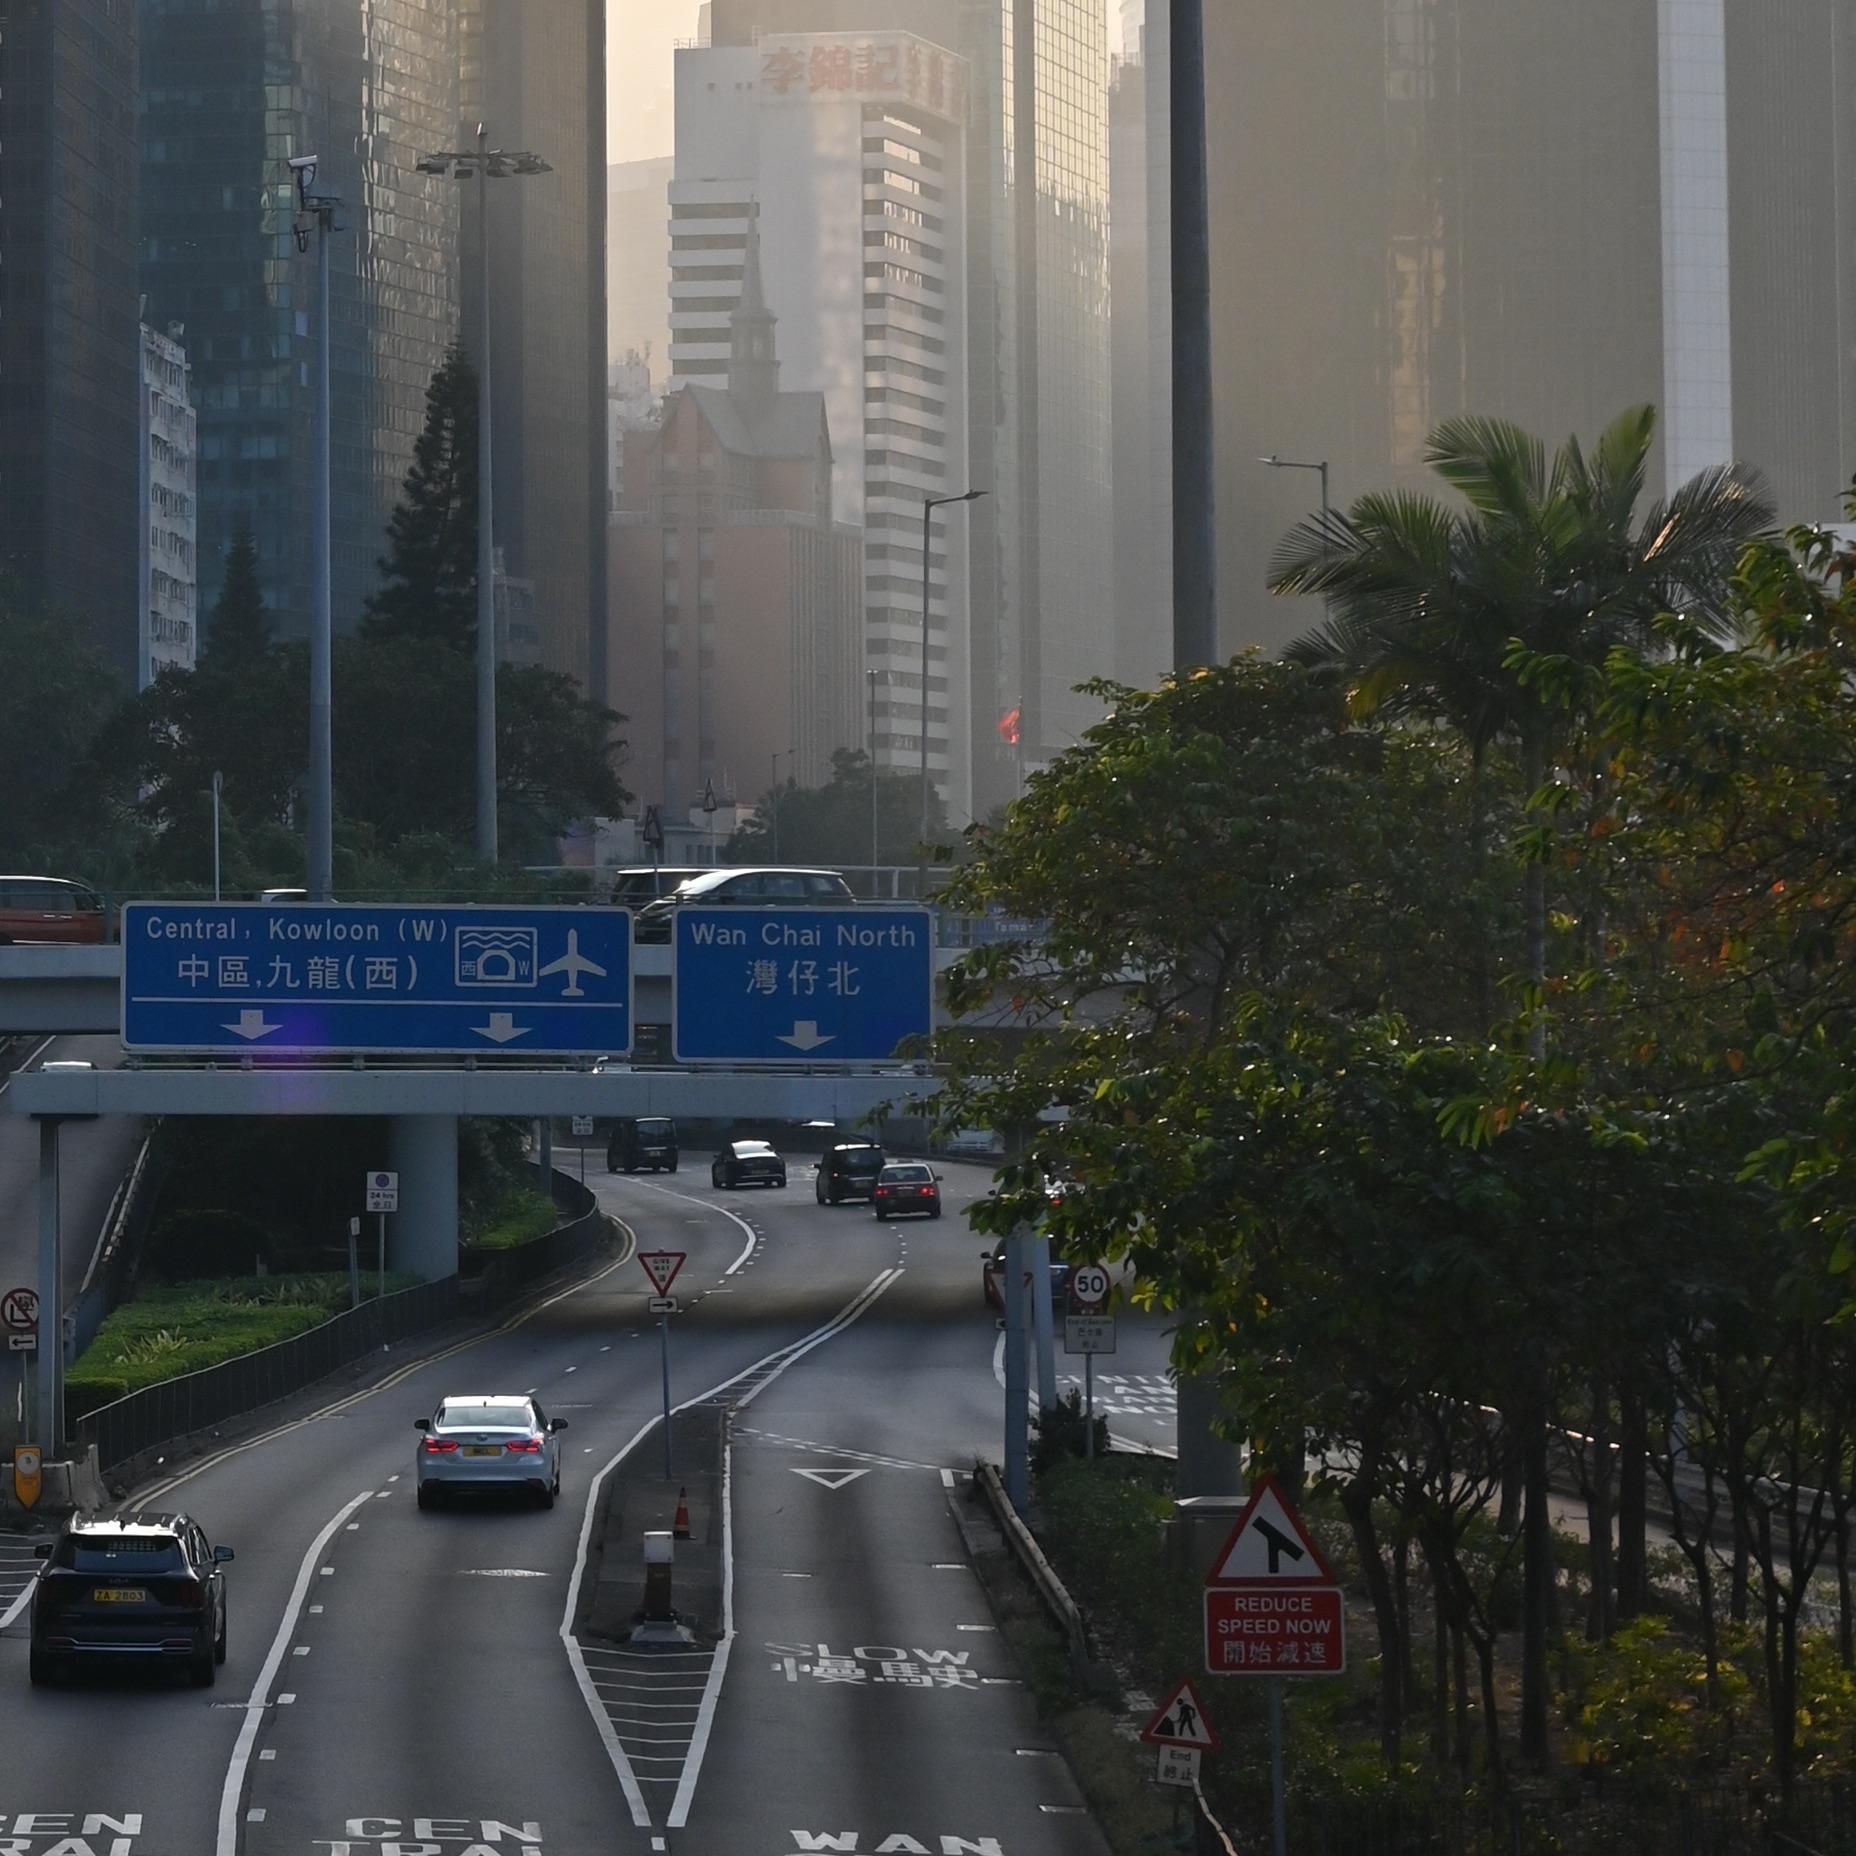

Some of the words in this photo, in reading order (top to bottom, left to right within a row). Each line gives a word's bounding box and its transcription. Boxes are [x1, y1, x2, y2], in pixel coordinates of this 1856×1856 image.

[761, 45, 899, 94] 李錦記
[269, 918, 379, 942] Kowloon
[398, 920, 448, 943] (W)
[692, 923, 746, 947] Wan
[761, 923, 821, 947] Chai
[837, 924, 916, 948] North
[518, 960, 530, 976] W
[746, 958, 861, 996] 灣仔北
[1078, 1276, 1103, 1293] 50
[95, 1590, 111, 1602] ZA
[1234, 1597, 1313, 1613] REDUCE
[1217, 1618, 1281, 1634] SPEED
[1286, 1618, 1331, 1634] NOW
[764, 1642, 970, 1665] SLOW
[1223, 1640, 1327, 1665] 開始減速
[1170, 1750, 1191, 1762] End
[345, 1817, 544, 1843] CEN
[790, 1827, 1004, 1856] WAN
